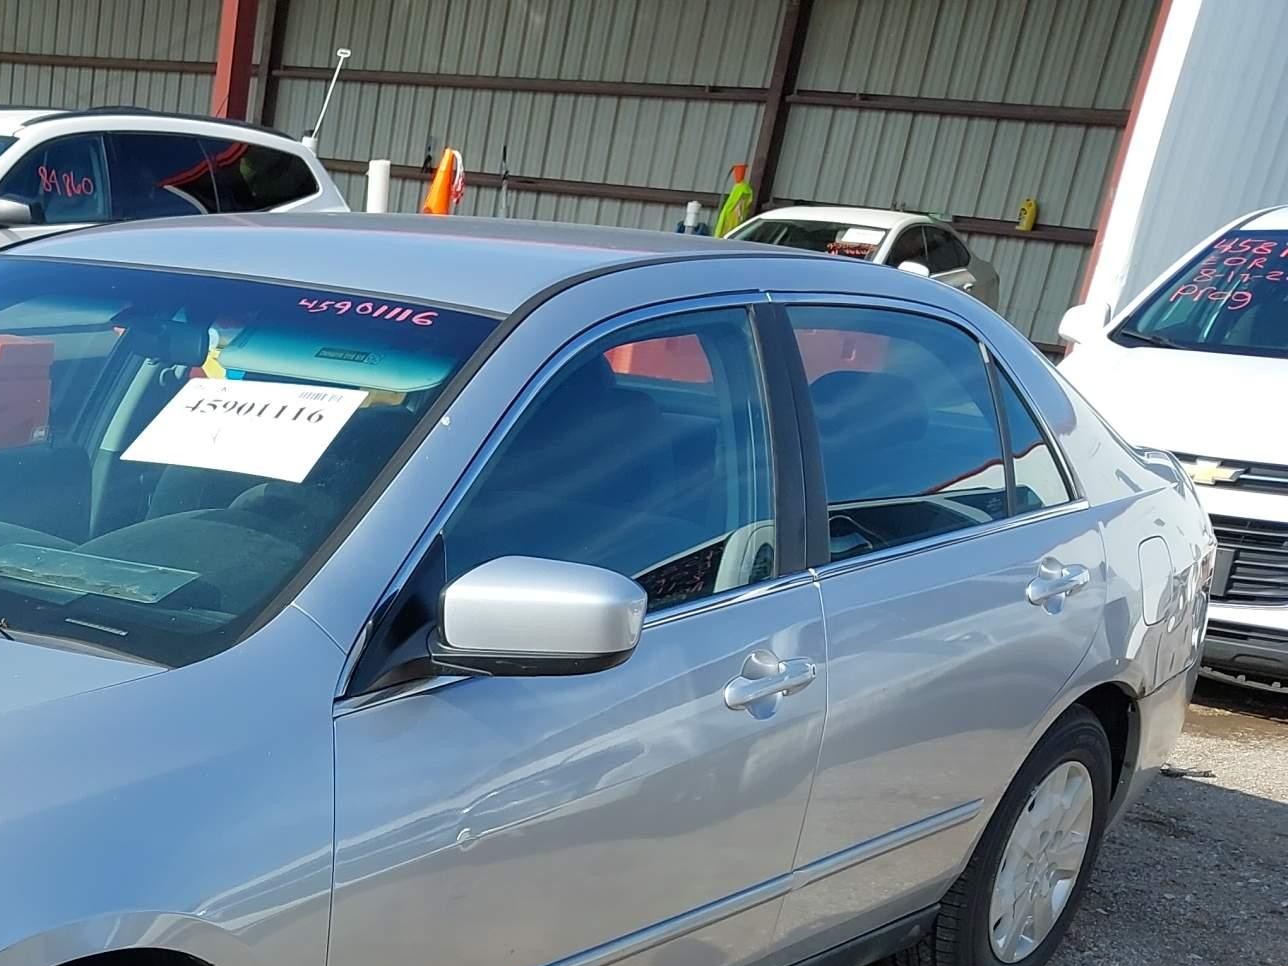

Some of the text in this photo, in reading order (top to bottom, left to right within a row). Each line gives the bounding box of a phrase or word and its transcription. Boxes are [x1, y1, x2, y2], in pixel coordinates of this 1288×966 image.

[1193, 268, 1288, 283] 8-17-2
[298, 298, 439, 326] 45901116
[185, 398, 325, 424] 45901116
